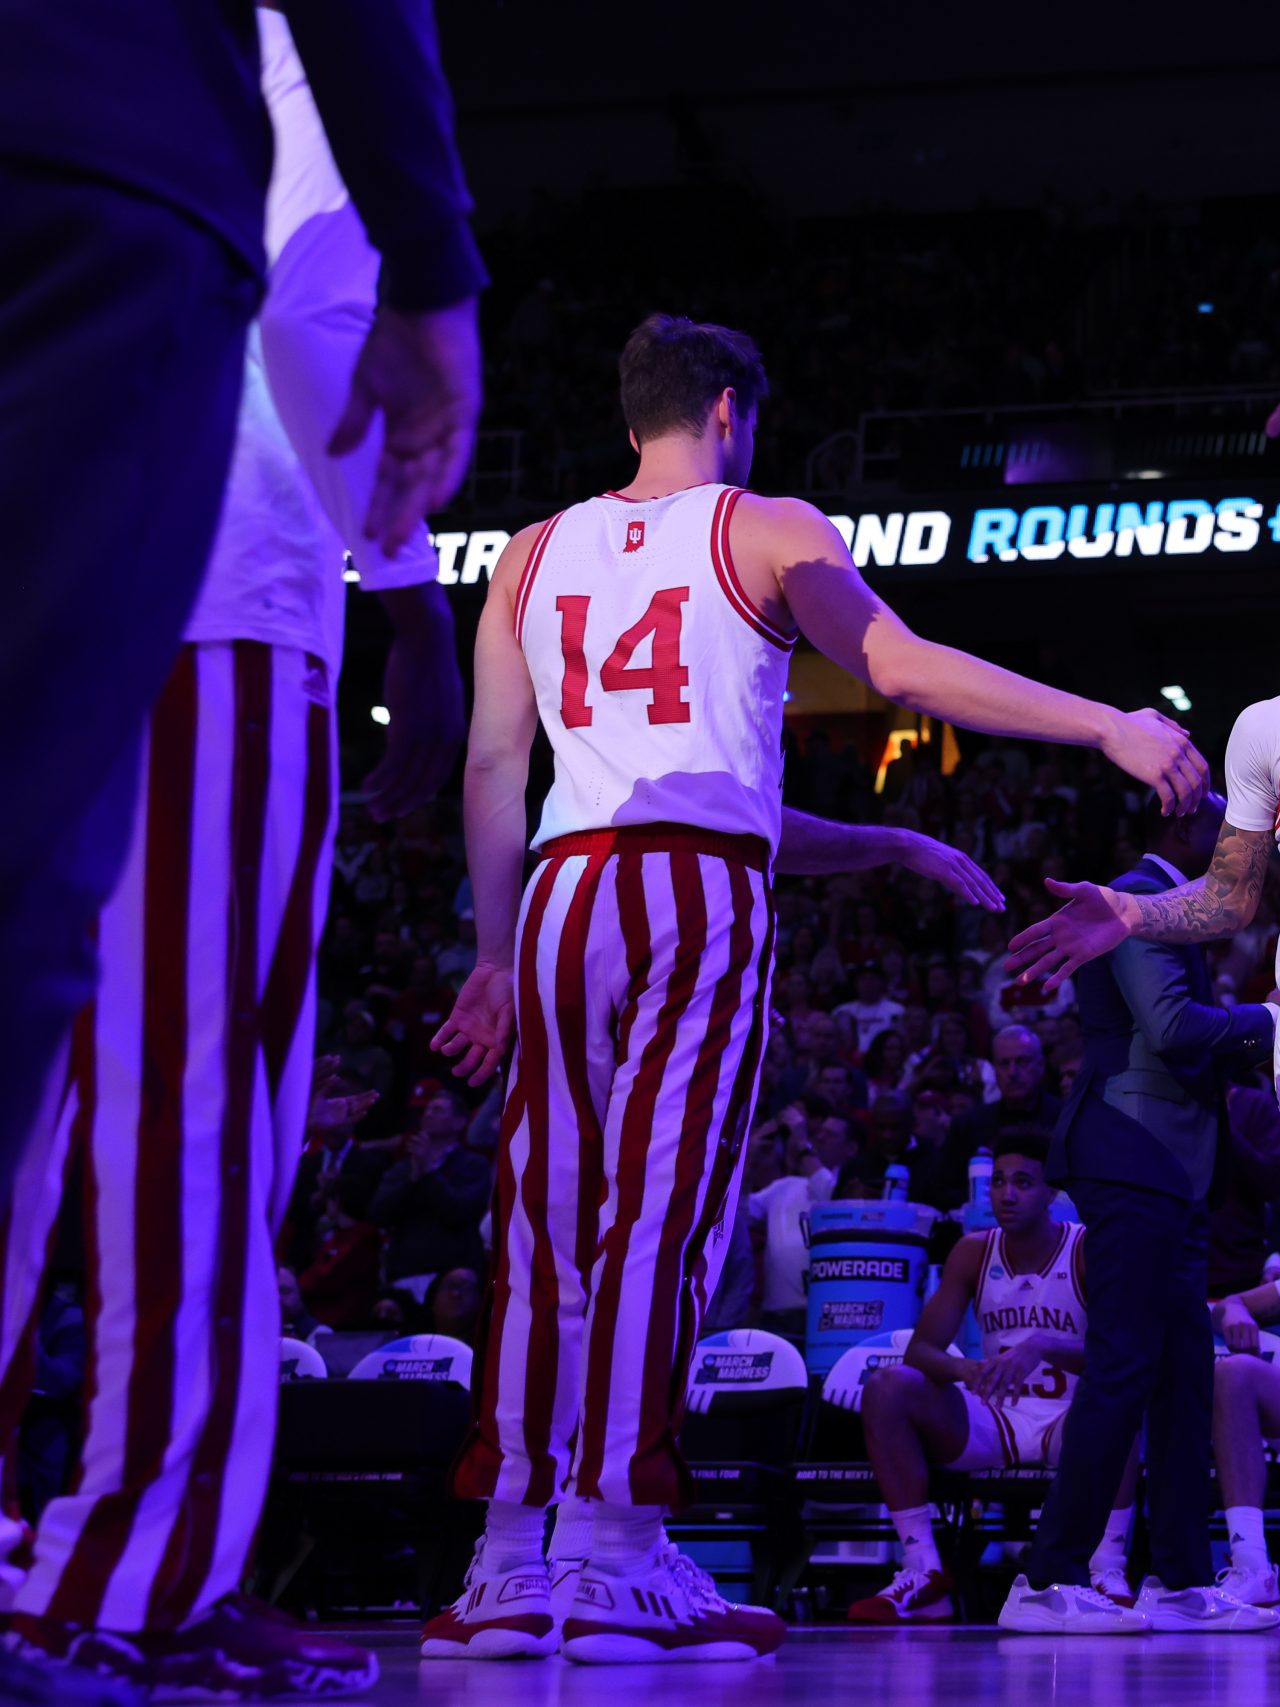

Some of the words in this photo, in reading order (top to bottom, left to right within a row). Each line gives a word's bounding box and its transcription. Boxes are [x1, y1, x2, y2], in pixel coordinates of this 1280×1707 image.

[967, 498, 1262, 563] ROUNDS
[556, 585, 690, 729] 14
[983, 1305, 1078, 1335] INDIANA
[714, 1355, 754, 1368] MARCH
[718, 1367, 769, 1379] MADNESS
